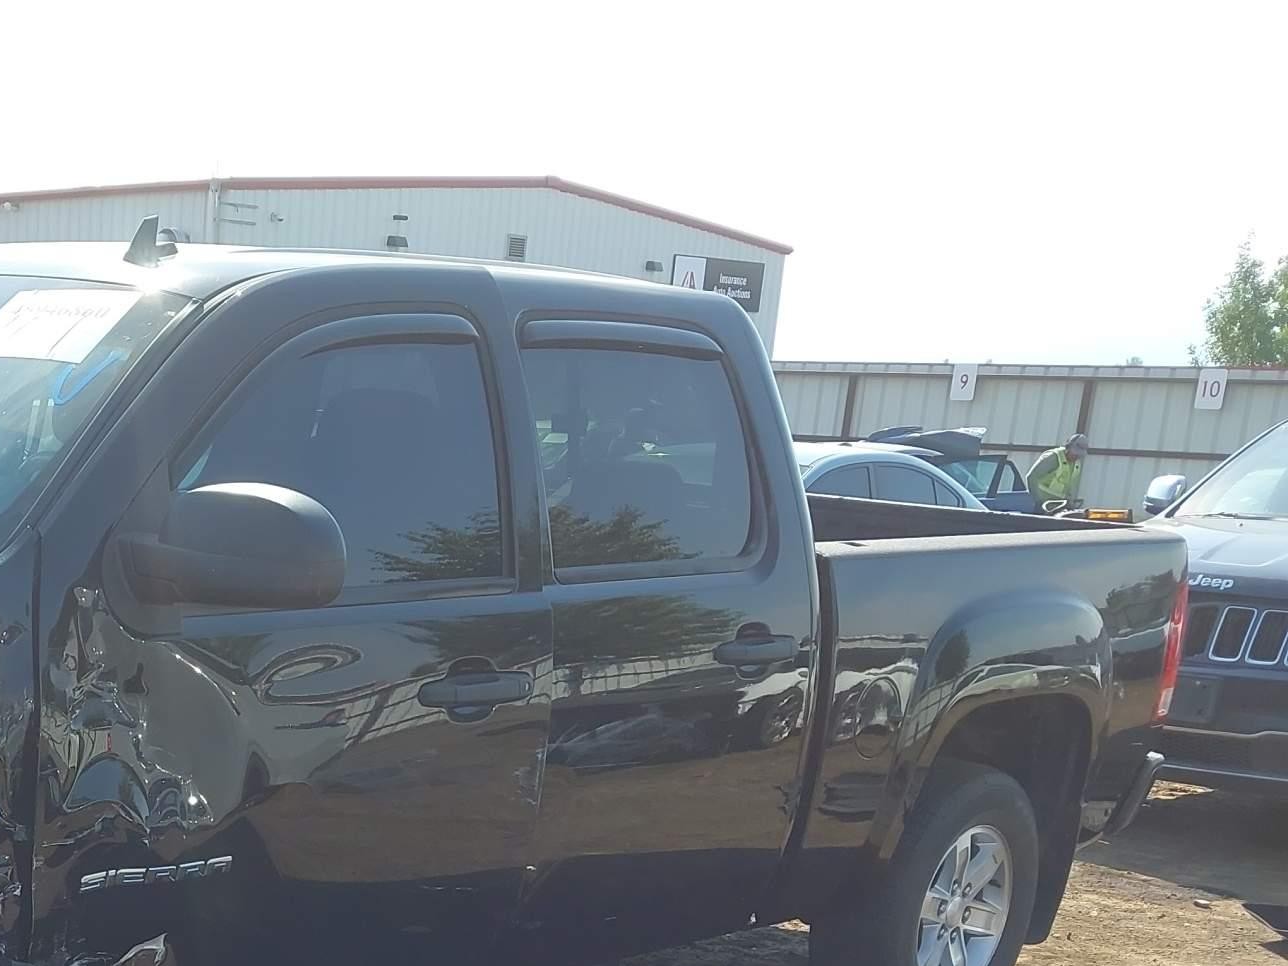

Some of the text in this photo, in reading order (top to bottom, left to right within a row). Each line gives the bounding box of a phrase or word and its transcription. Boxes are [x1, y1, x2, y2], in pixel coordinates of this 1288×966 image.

[719, 272, 747, 286] Insurance
[727, 286, 751, 299] Auctions
[960, 373, 969, 390] 9
[1202, 380, 1221, 398] 10
[1188, 574, 1234, 590] Jeep
[79, 855, 233, 893] SIERRA
